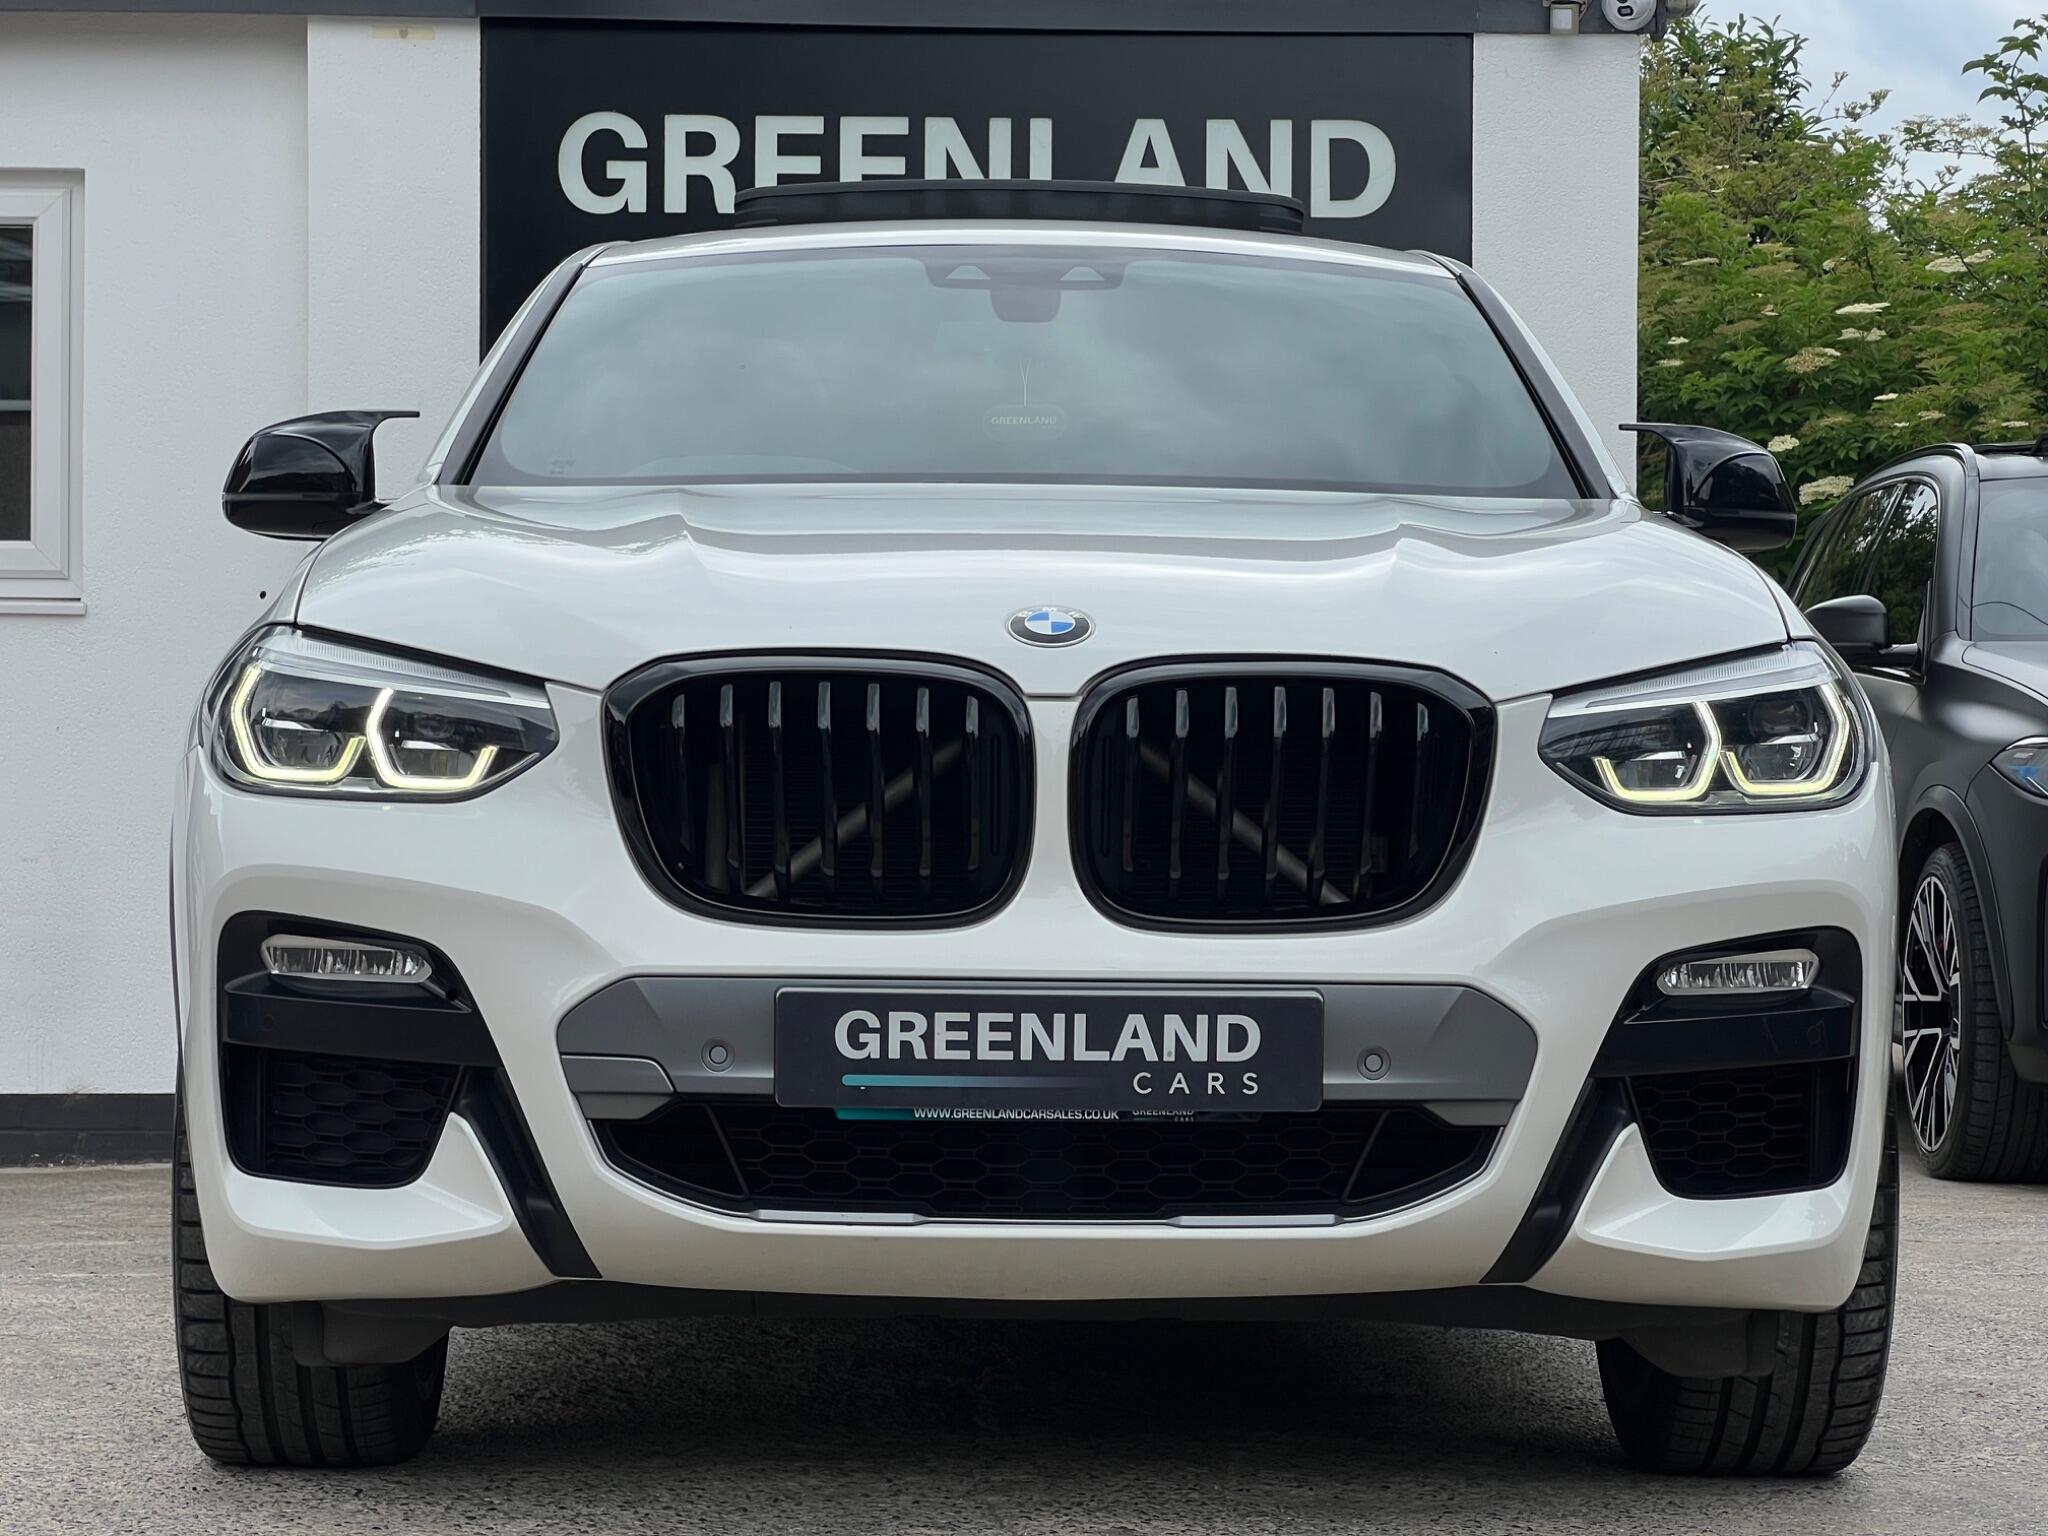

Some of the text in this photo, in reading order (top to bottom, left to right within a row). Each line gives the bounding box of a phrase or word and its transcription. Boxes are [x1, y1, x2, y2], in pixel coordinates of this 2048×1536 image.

[991, 415, 1057, 425] GREENLAND
[834, 1010, 1262, 1063] GREENLAND
[1132, 1071, 1260, 1095] CARS
[914, 1107, 1119, 1120] WWW.GREENLANDCARSALES.CO.UK
